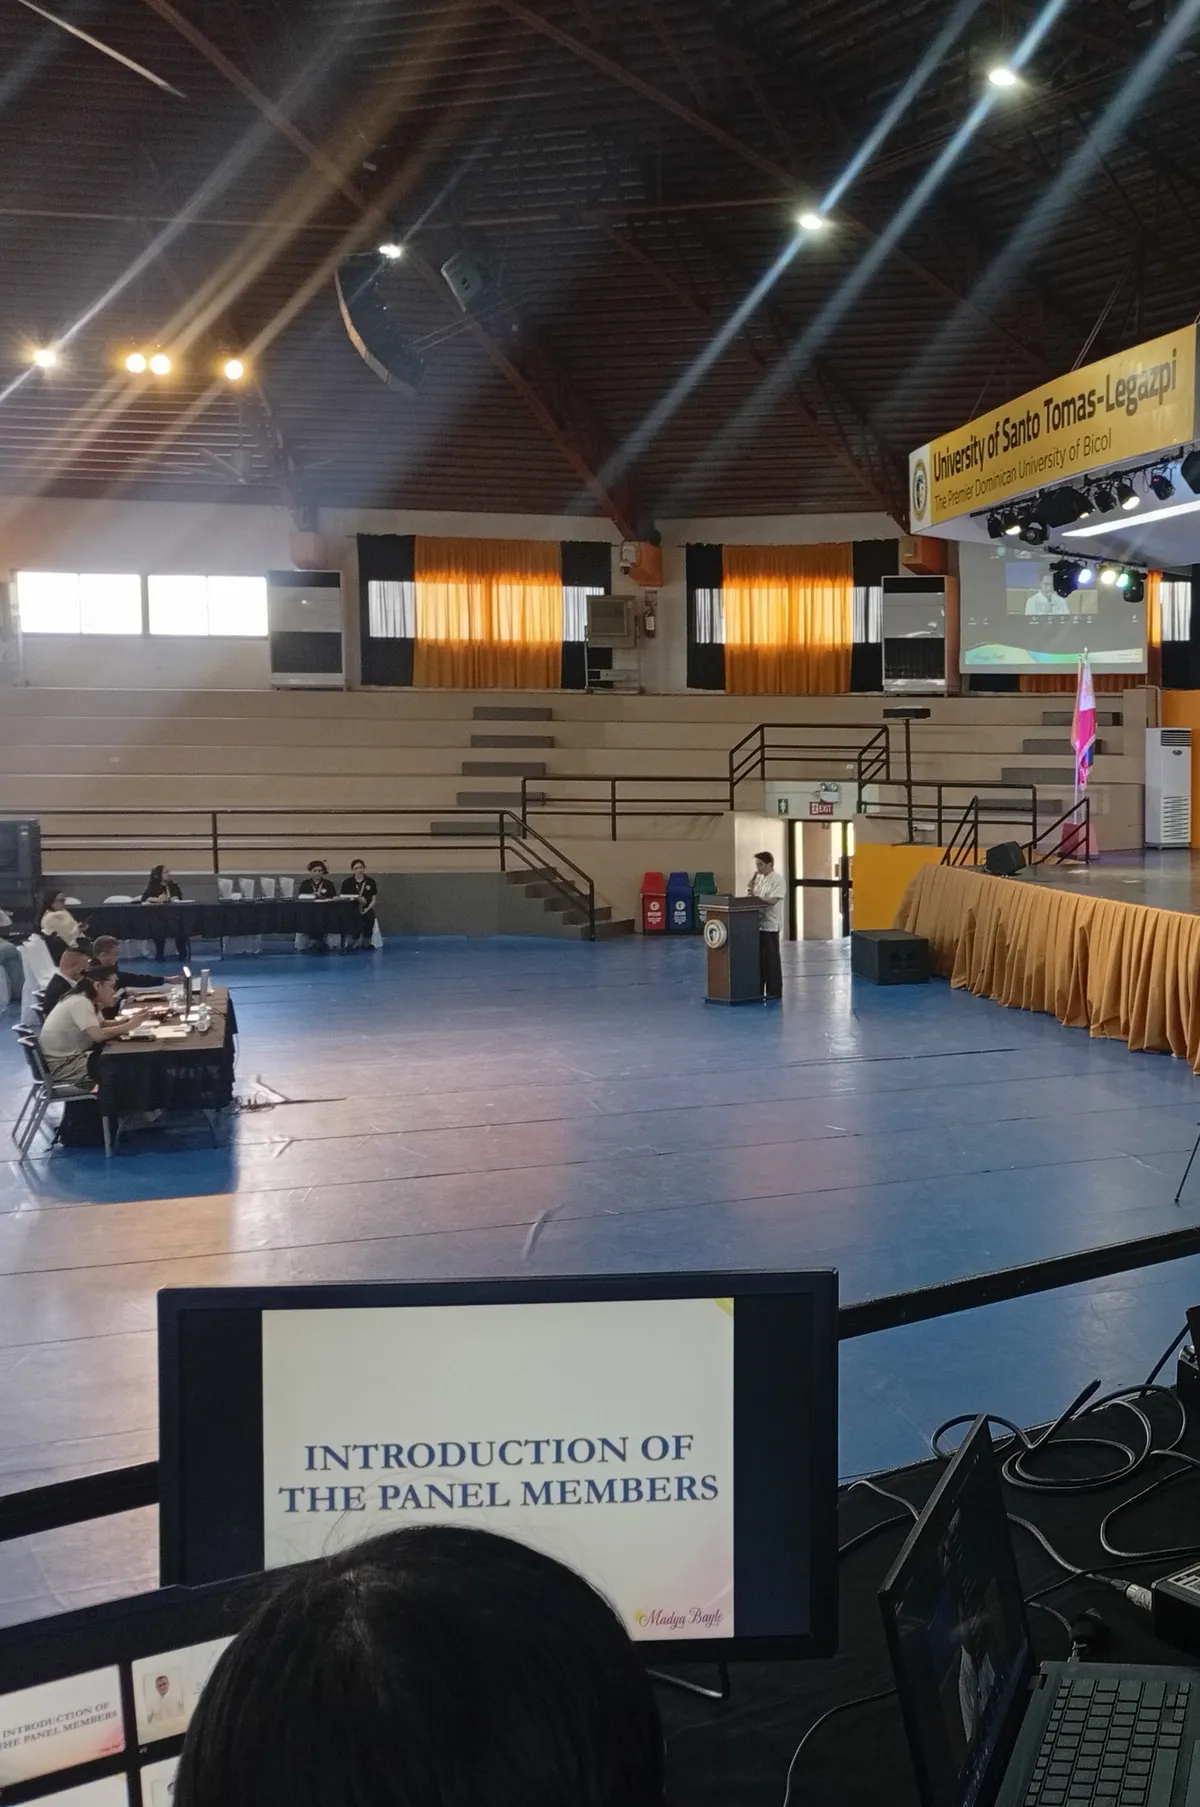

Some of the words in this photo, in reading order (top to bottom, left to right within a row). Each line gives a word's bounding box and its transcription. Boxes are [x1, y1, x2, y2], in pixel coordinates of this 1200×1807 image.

[934, 436, 985, 482] University
[988, 421, 1001, 459] of
[1002, 411, 1040, 453] Santo
[1043, 348, 1177, 434] Tomas-Legazpi
[935, 490, 948, 512] The
[948, 482, 974, 506] Premier
[975, 468, 1016, 498] Dominican
[1018, 445, 1066, 480] University
[1069, 439, 1081, 461] of
[1083, 428, 1112, 458] Bicol
[819, 804, 832, 813] EXIT
[304, 1435, 629, 1472] INTRODUCTION
[641, 1433, 694, 1463] OF
[278, 1484, 367, 1514] THE
[378, 1481, 511, 1511] PANEL
[520, 1473, 719, 1507] MEMBERS
[639, 1608, 688, 1630] Madya
[688, 1606, 723, 1629] Bayle
[2, 1705, 92, 1739] INTRODUCTION
[95, 1701, 111, 1713] OF
[23, 1727, 61, 1745] PANEL
[63, 1709, 118, 1732] MEMBERS
